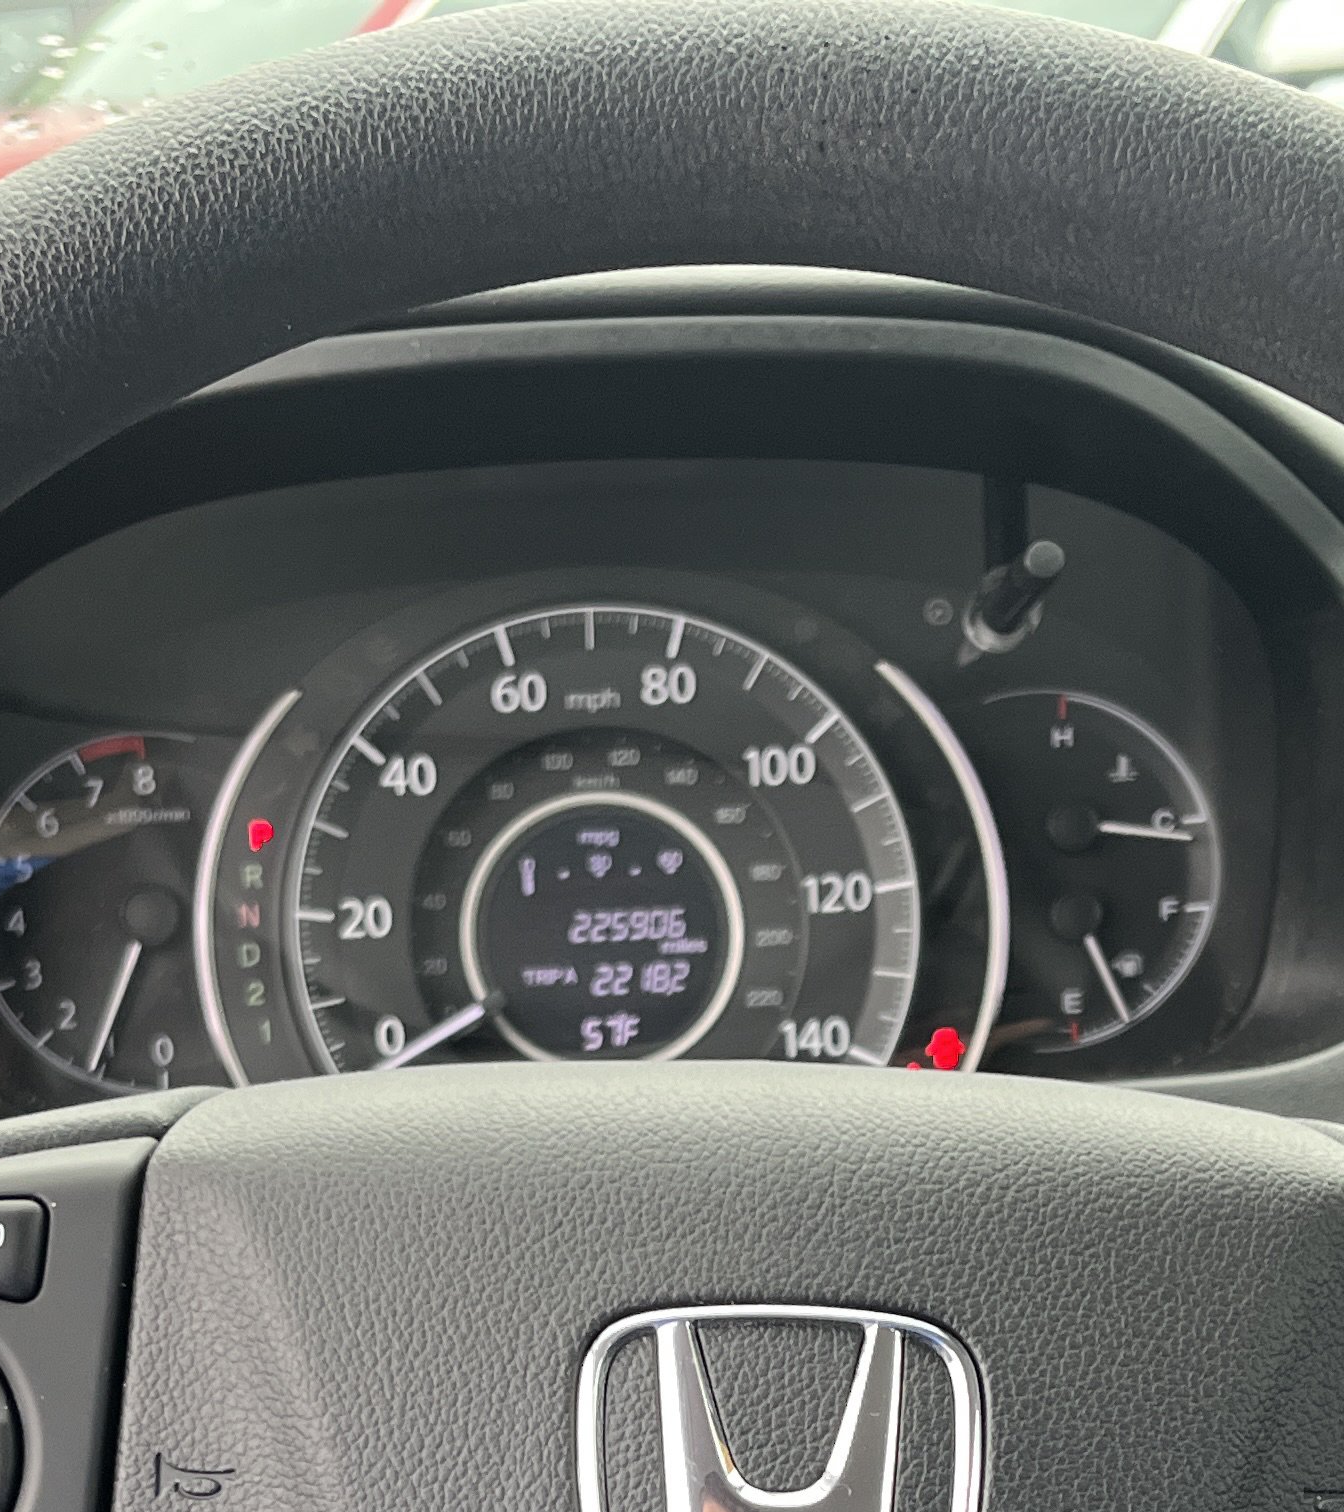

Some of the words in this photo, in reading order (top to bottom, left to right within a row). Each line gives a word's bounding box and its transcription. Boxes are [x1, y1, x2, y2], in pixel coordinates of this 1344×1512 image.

[491, 672, 547, 713] 60
[641, 664, 696, 705] 80
[564, 689, 620, 713] mph
[1050, 724, 1075, 749] H
[132, 763, 156, 796] 8
[379, 754, 437, 796] 40
[743, 746, 816, 787] 100
[85, 777, 104, 809] 7
[36, 810, 60, 838] 6
[247, 818, 274, 852] P
[1152, 807, 1177, 834] C
[15, 854, 34, 883] 5
[242, 865, 263, 889] R
[801, 873, 872, 914] 120
[1158, 897, 1180, 920] F
[6, 907, 27, 937] 4
[237, 904, 260, 928] N
[339, 896, 393, 939] 20
[240, 943, 260, 967] D
[24, 957, 42, 990] 3
[247, 982, 265, 1006] 2
[1060, 988, 1085, 1015] E
[59, 998, 76, 1030] 2
[261, 1020, 271, 1043] 1
[374, 1015, 406, 1056] 0
[779, 1017, 850, 1057] 140
[153, 1034, 174, 1067] 0
